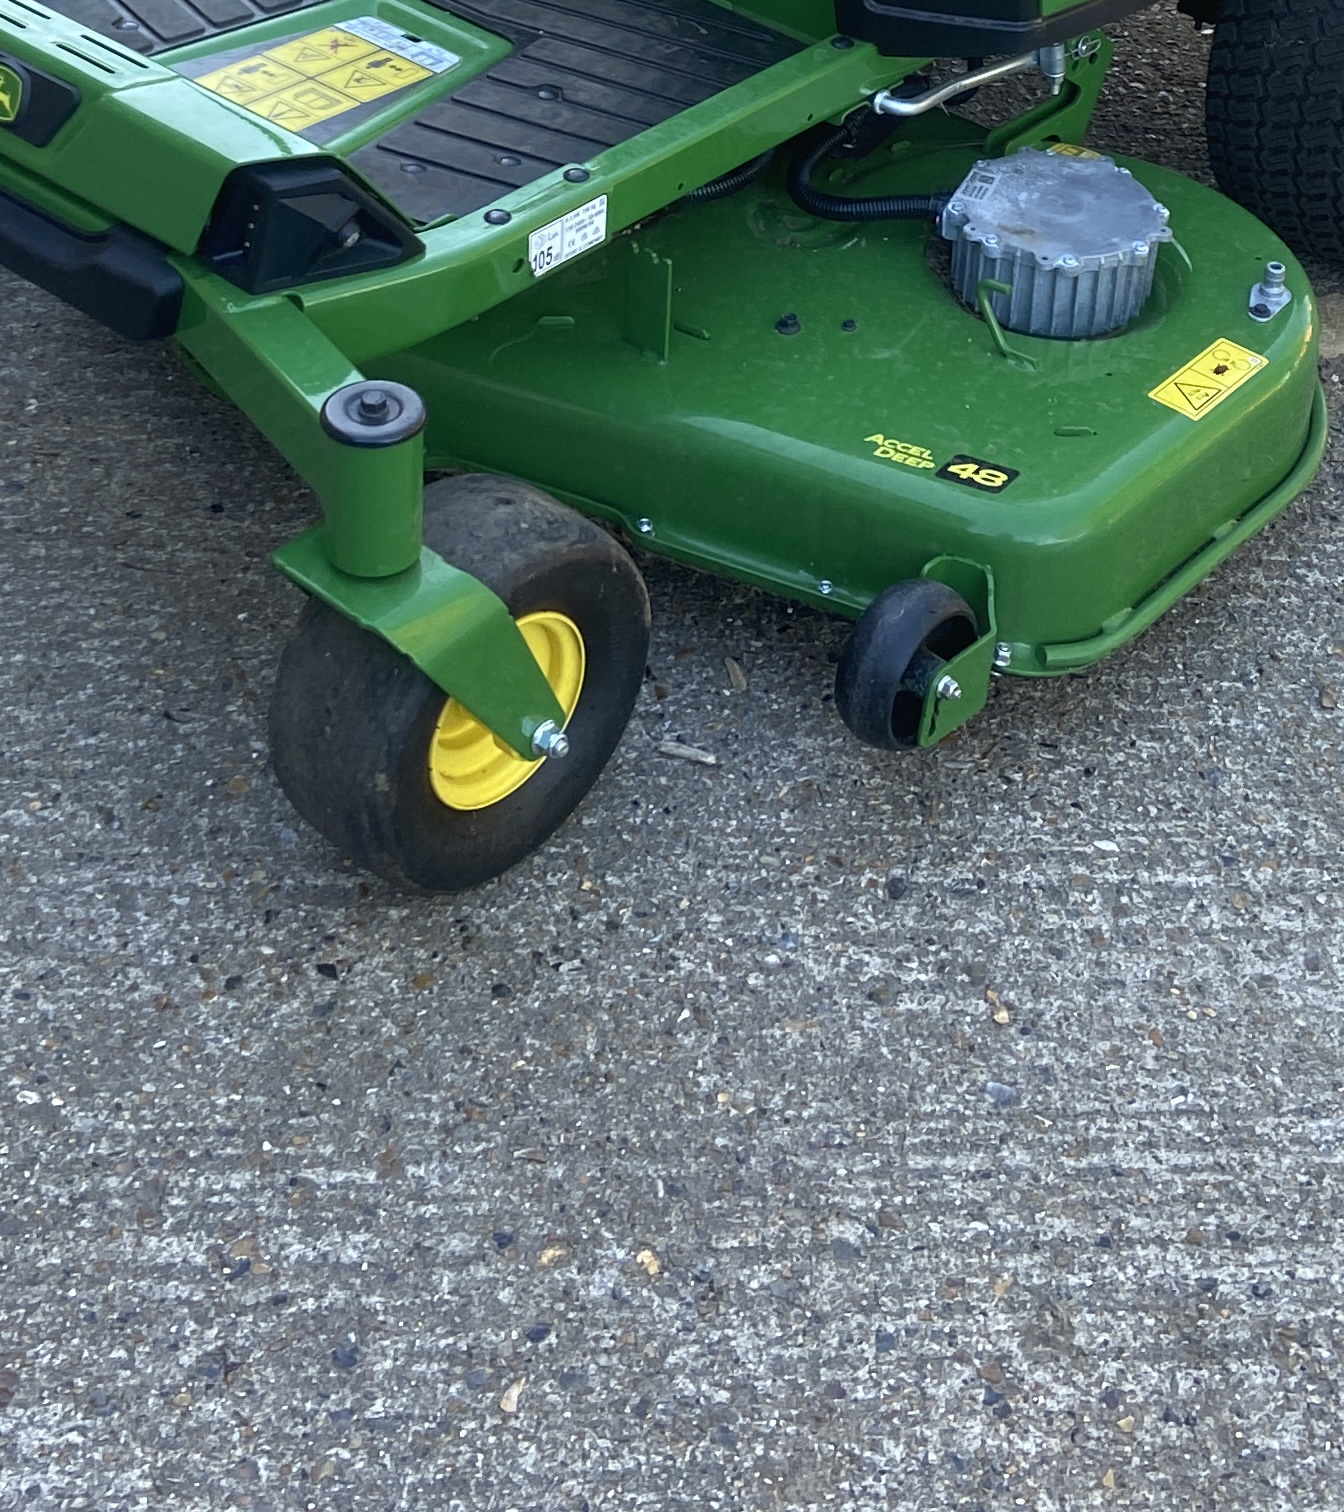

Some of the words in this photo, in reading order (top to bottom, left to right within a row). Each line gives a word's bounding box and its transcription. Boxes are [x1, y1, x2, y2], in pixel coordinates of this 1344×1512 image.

[533, 246, 553, 272] 105
[863, 433, 934, 460] ACCEL
[873, 446, 937, 470] DEEP
[947, 463, 1009, 488] 48
